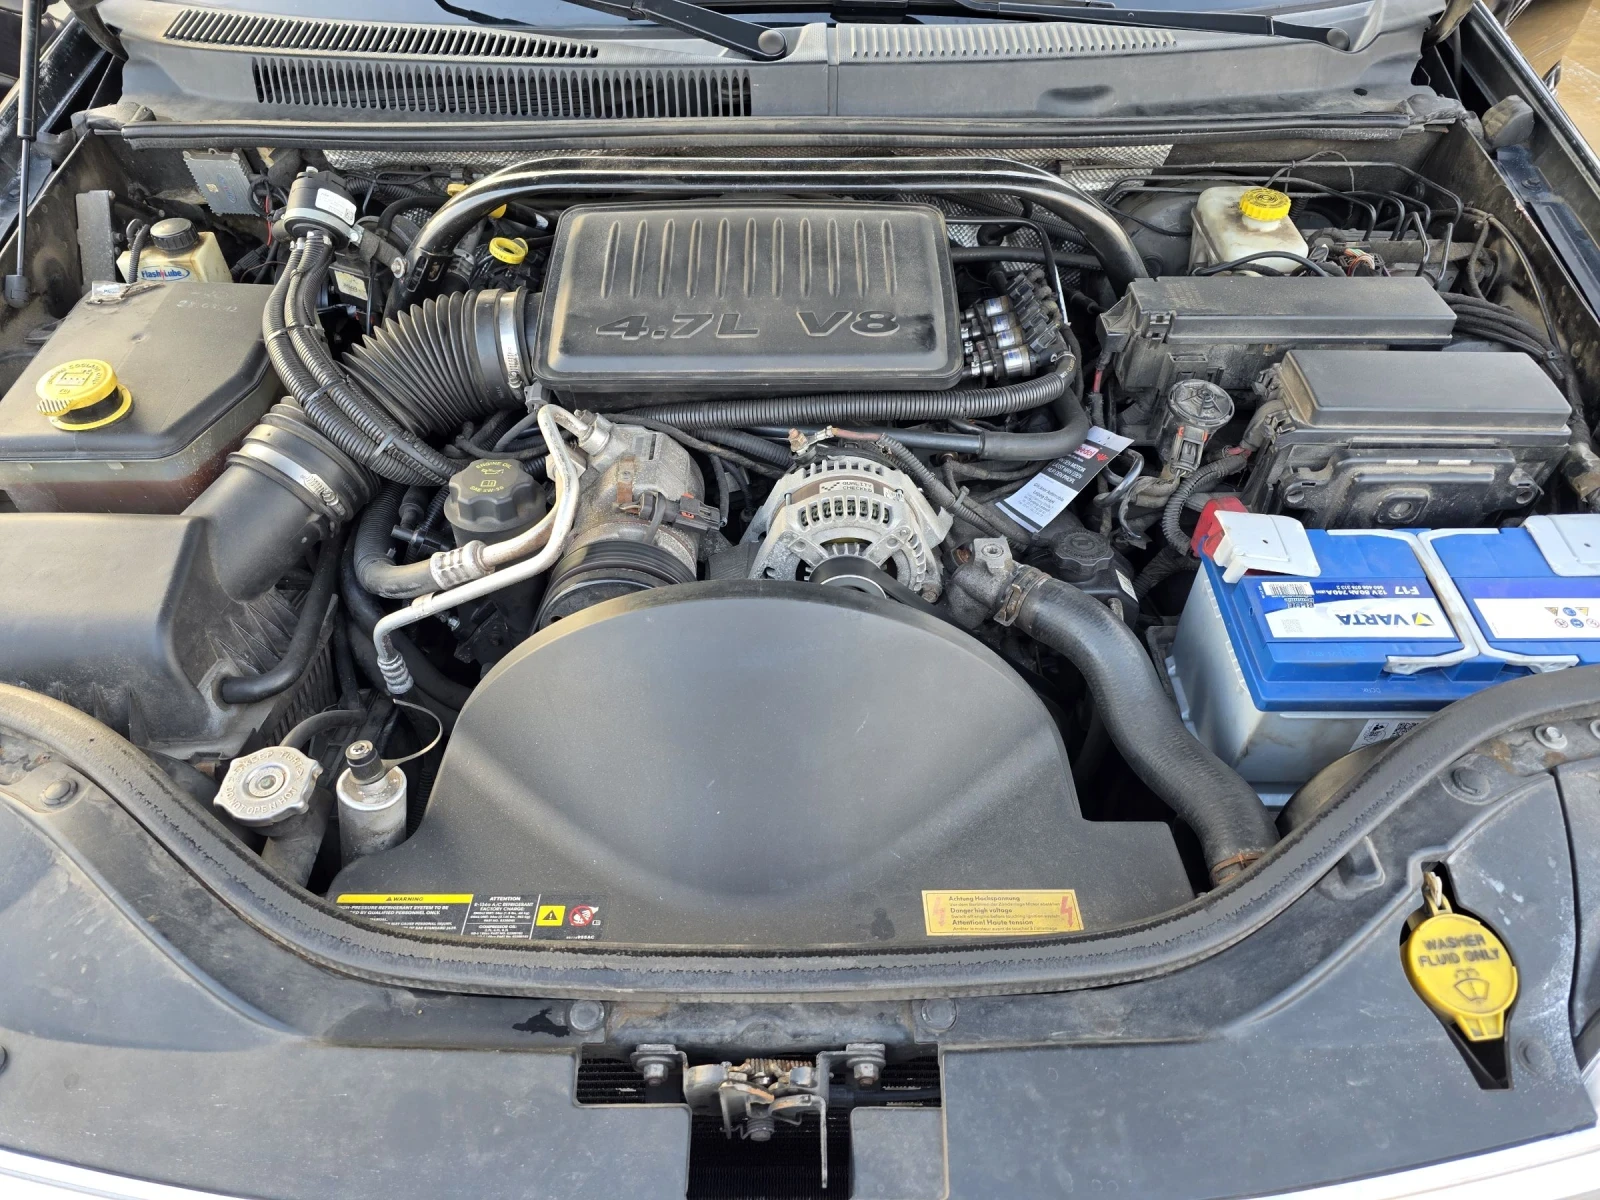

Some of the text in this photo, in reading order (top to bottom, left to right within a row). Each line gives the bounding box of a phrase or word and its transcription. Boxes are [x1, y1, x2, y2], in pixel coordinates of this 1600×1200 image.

[597, 310, 900, 340] 4.7L V8
[1395, 586, 1420, 595] F17
[1334, 614, 1410, 626] VARTA
[243, 752, 274, 766] KEEP
[1423, 934, 1487, 950] WASHER
[1418, 948, 1500, 968] FLUID ONLY
